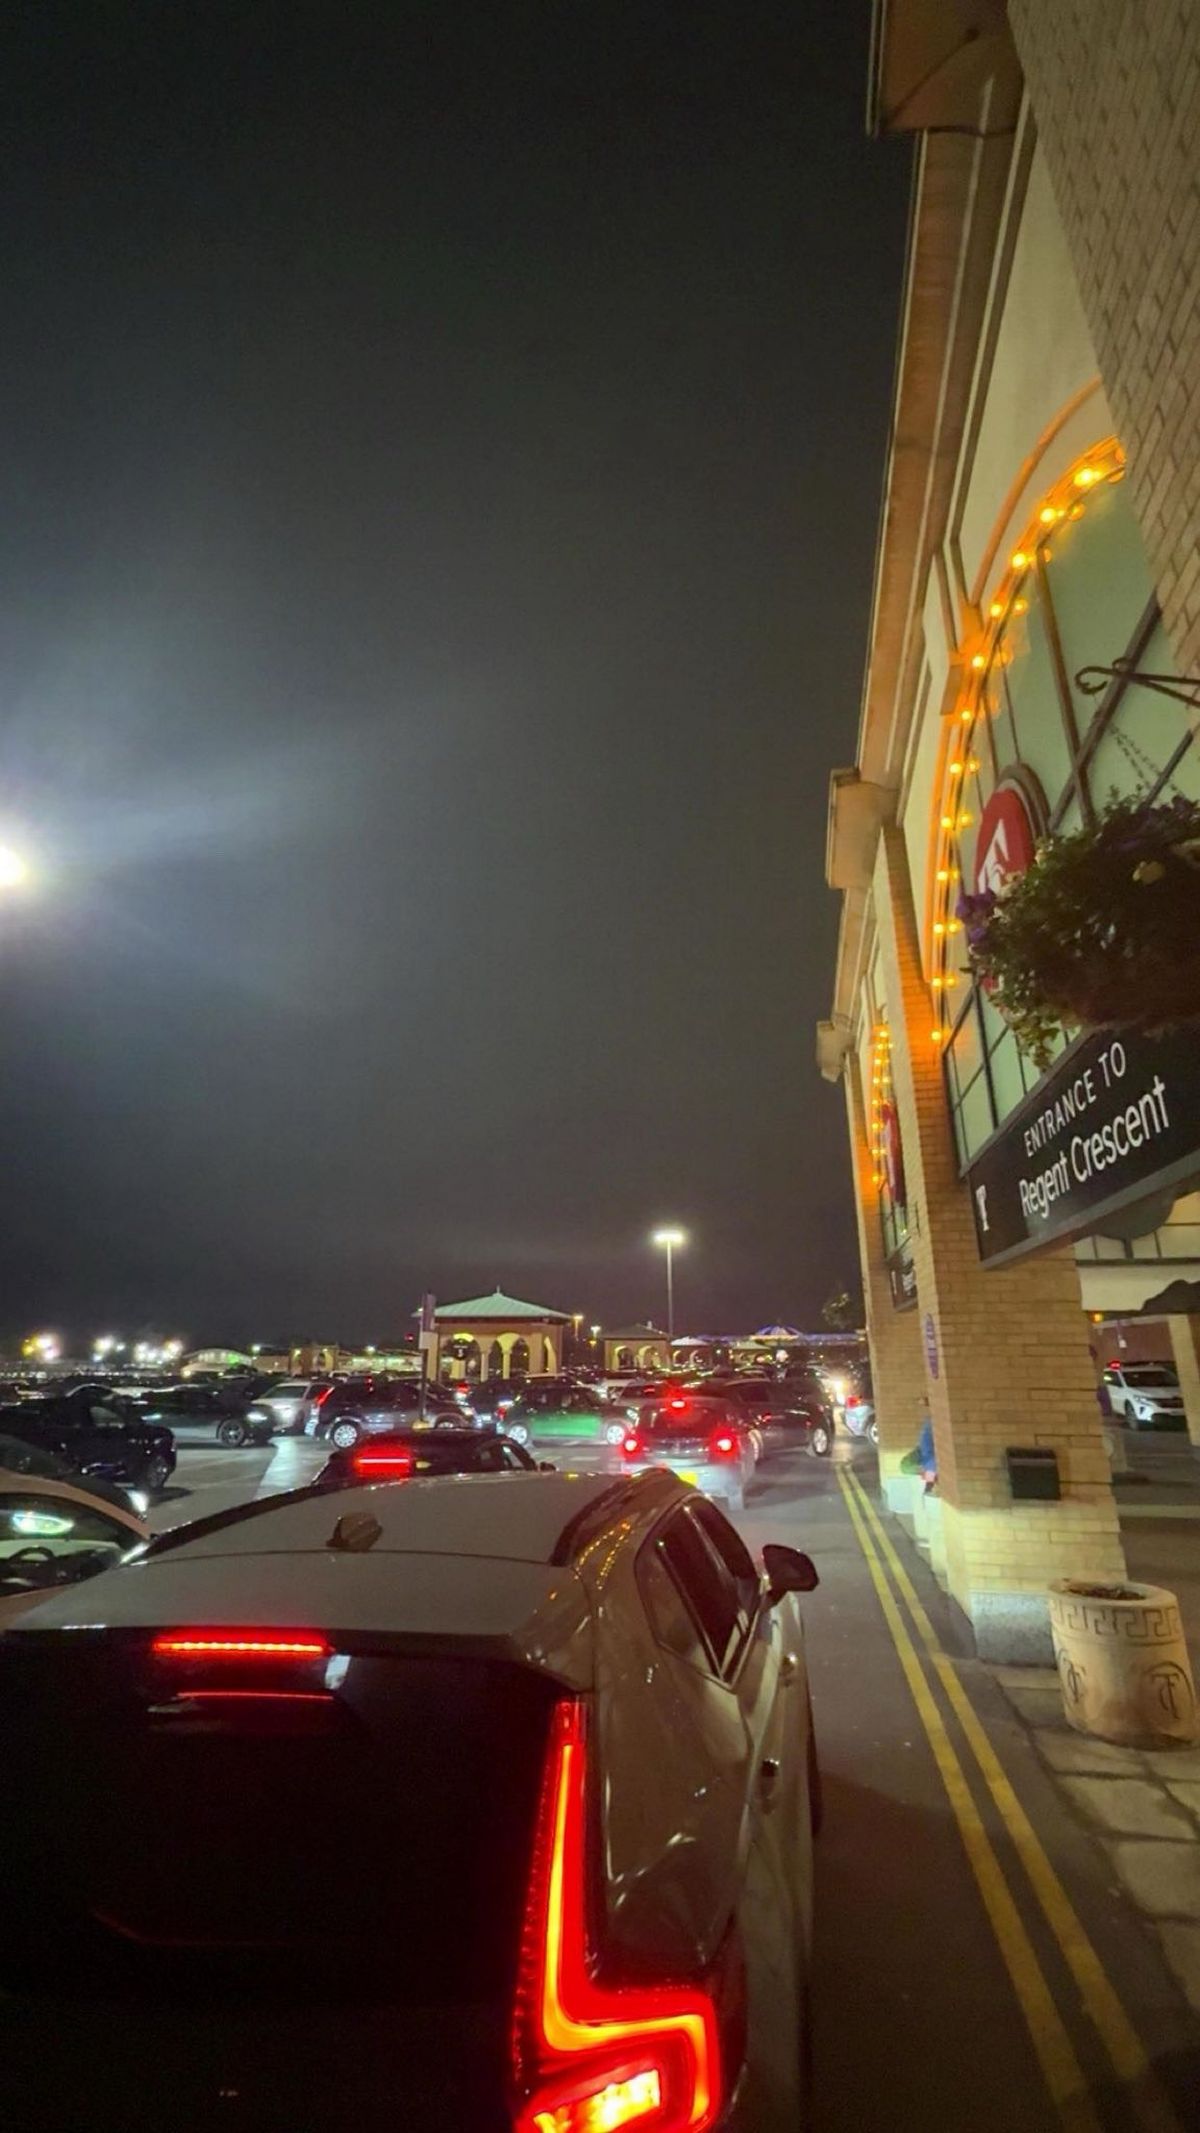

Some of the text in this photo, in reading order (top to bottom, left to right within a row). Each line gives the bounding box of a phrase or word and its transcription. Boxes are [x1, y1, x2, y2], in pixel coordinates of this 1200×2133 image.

[1018, 1074, 1170, 1219] Regent Crescent
[1023, 1042, 1126, 1158] ENTRANCE TO
